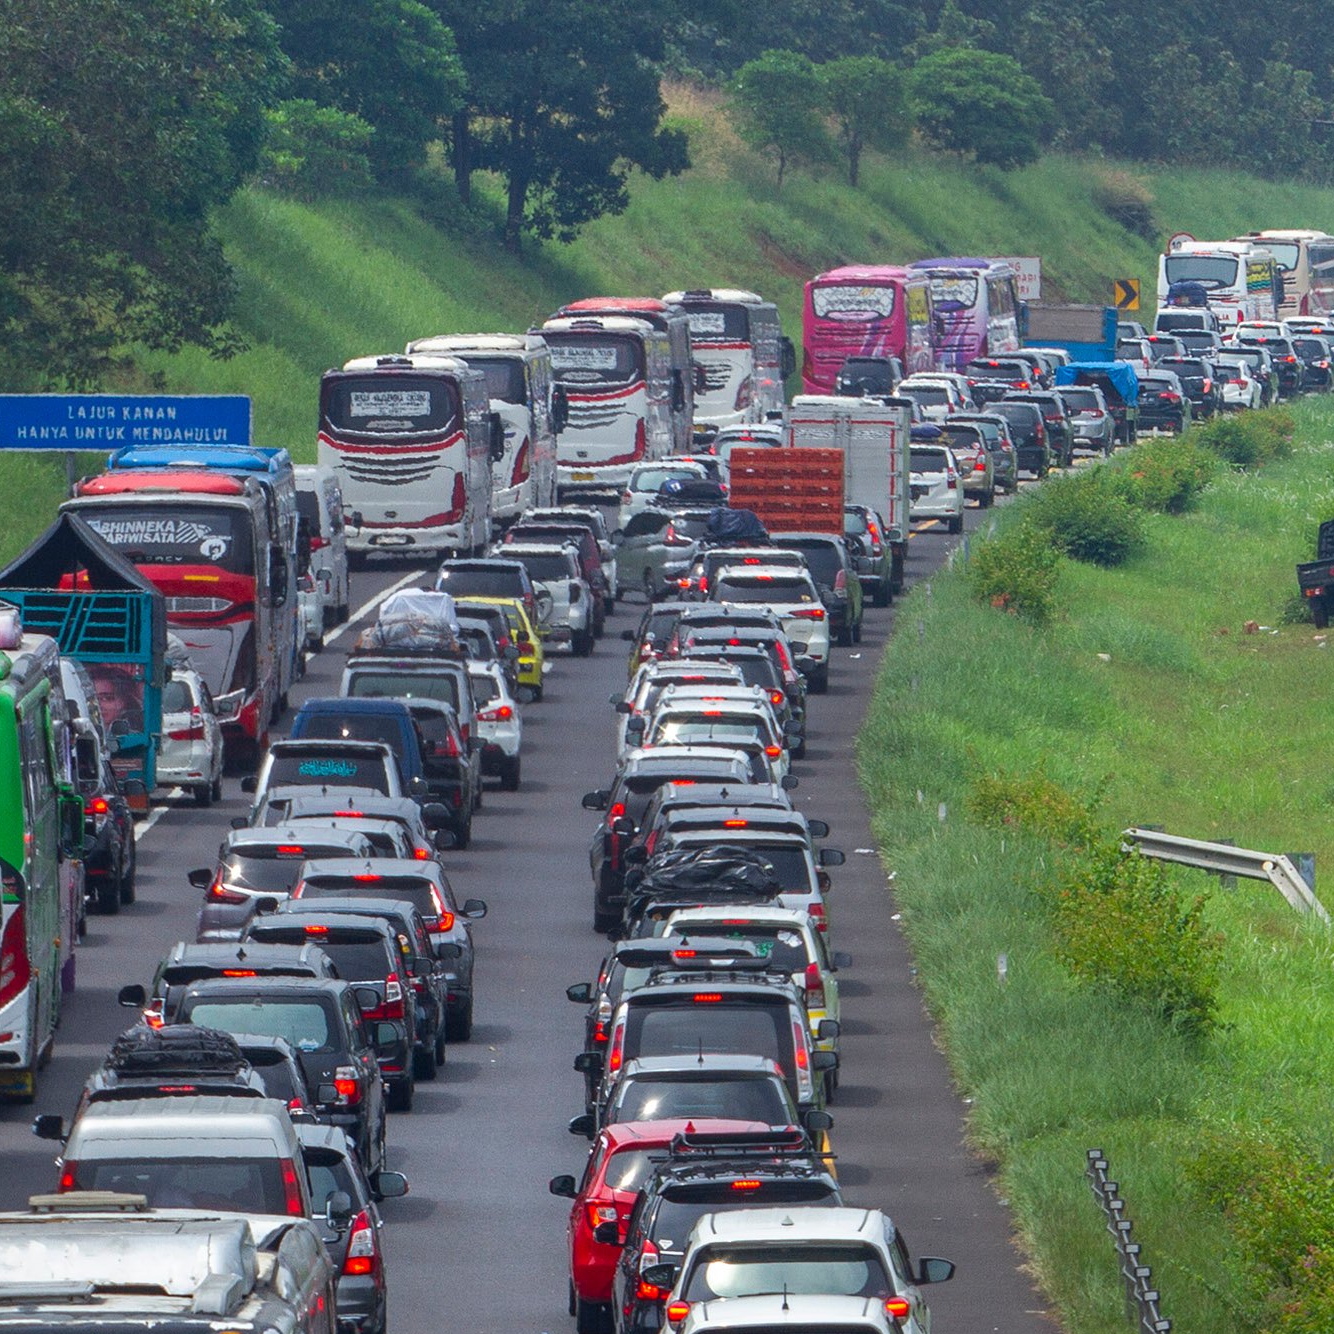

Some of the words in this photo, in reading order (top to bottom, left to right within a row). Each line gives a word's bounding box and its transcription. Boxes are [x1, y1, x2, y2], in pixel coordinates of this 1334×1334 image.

[68, 405, 115, 420] LAJUR
[122, 406, 177, 420] KANAN
[17, 425, 58, 439] HANYA
[65, 425, 125, 440] UNTUK
[132, 426, 228, 442] MENDAHULUI
[102, 520, 176, 534] BHINNEKA
